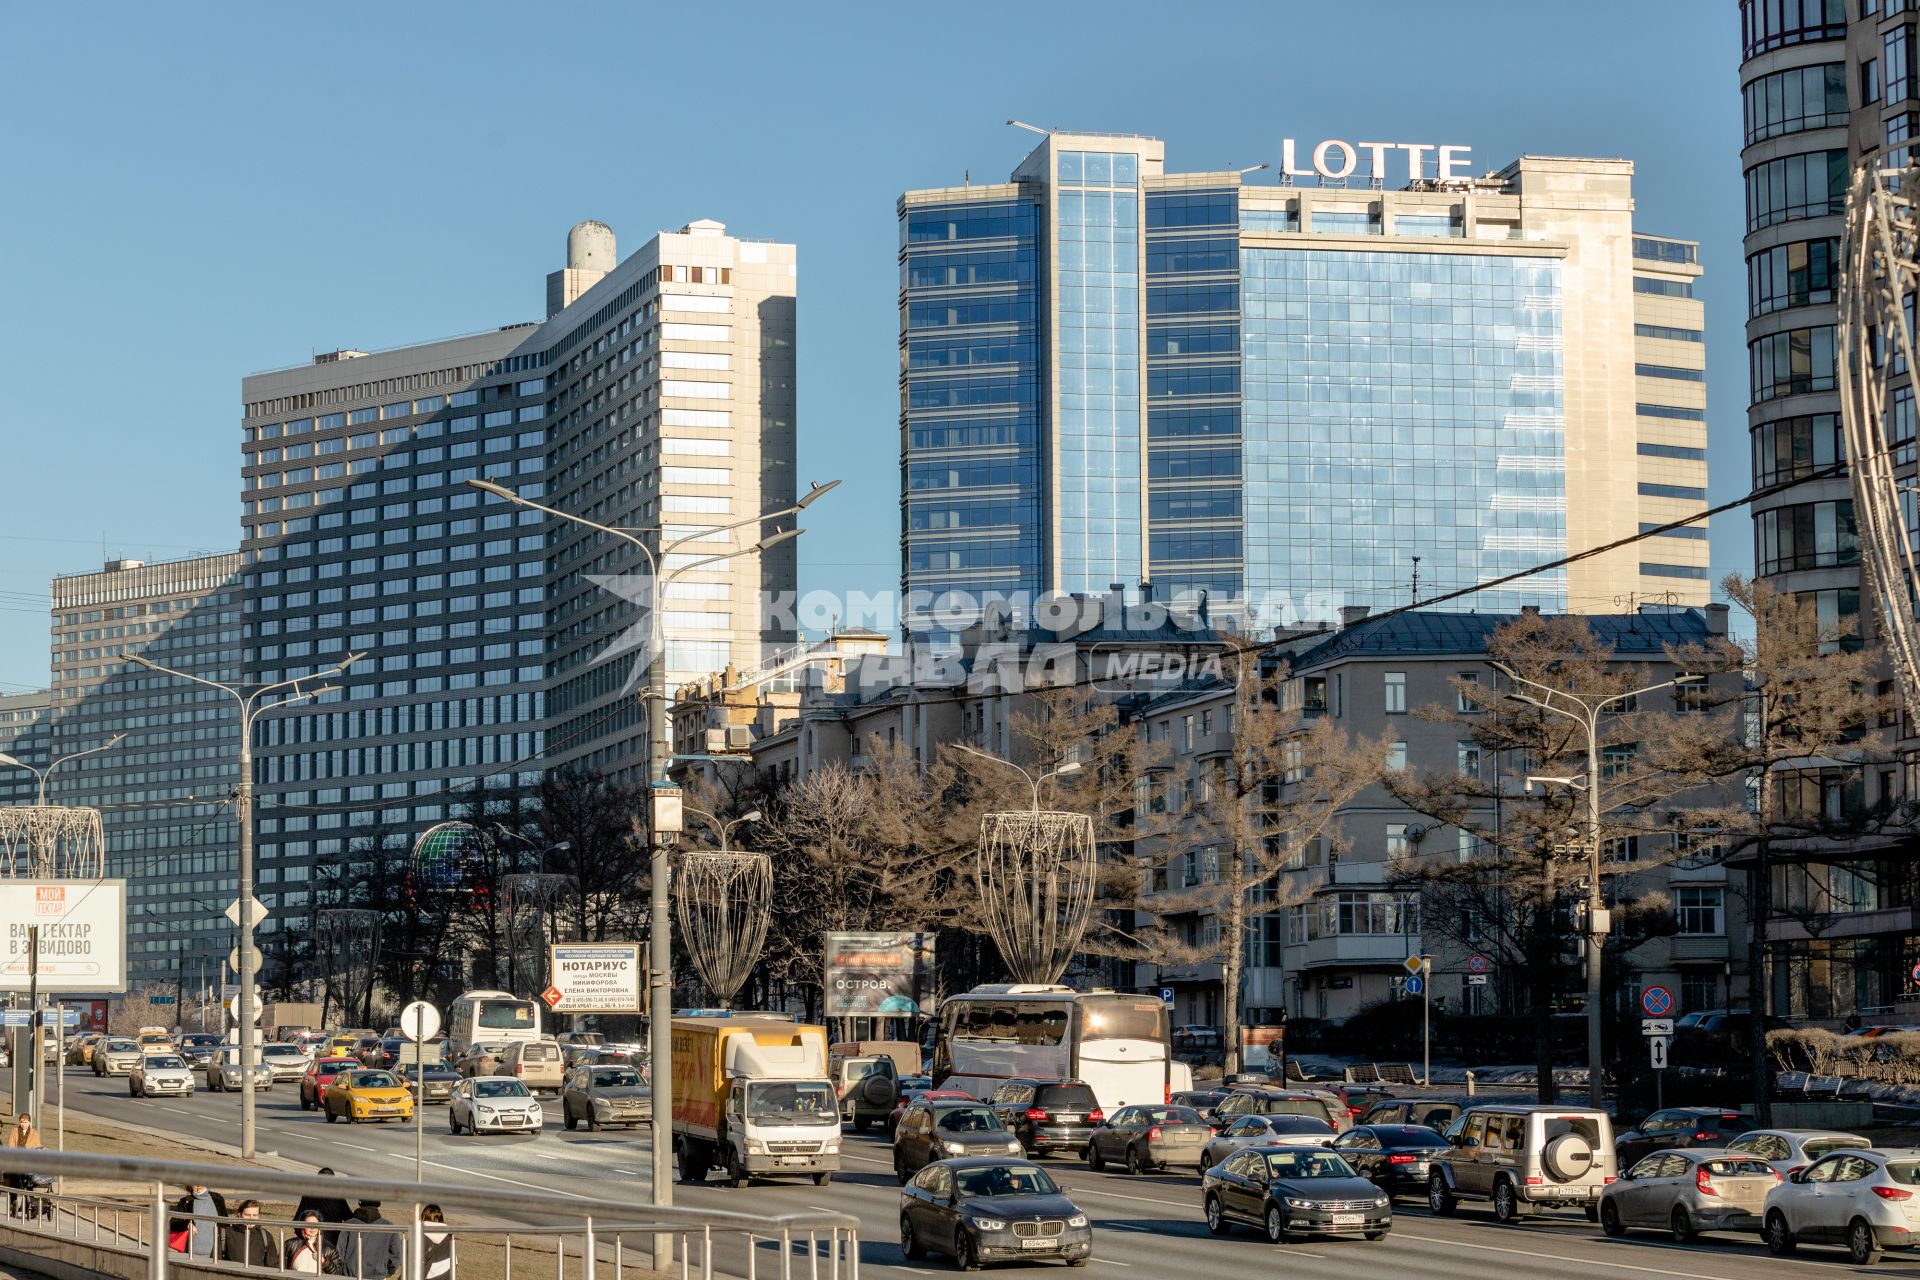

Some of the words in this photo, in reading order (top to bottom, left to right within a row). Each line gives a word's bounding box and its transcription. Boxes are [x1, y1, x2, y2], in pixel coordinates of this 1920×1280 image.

[1283, 138, 1472, 181] LOTTE
[40, 887, 61, 900] МОЙ
[38, 903, 62, 914] ГЕКТАР
[10, 923, 38, 938] ВА
[43, 923, 91, 938] ГЕКТАР
[10, 940, 18, 955] В
[22, 940, 91, 956] ЗВИДОВО
[562, 961, 628, 971] НОТАРИУС
[835, 979, 892, 990] ОСТРОВ.
